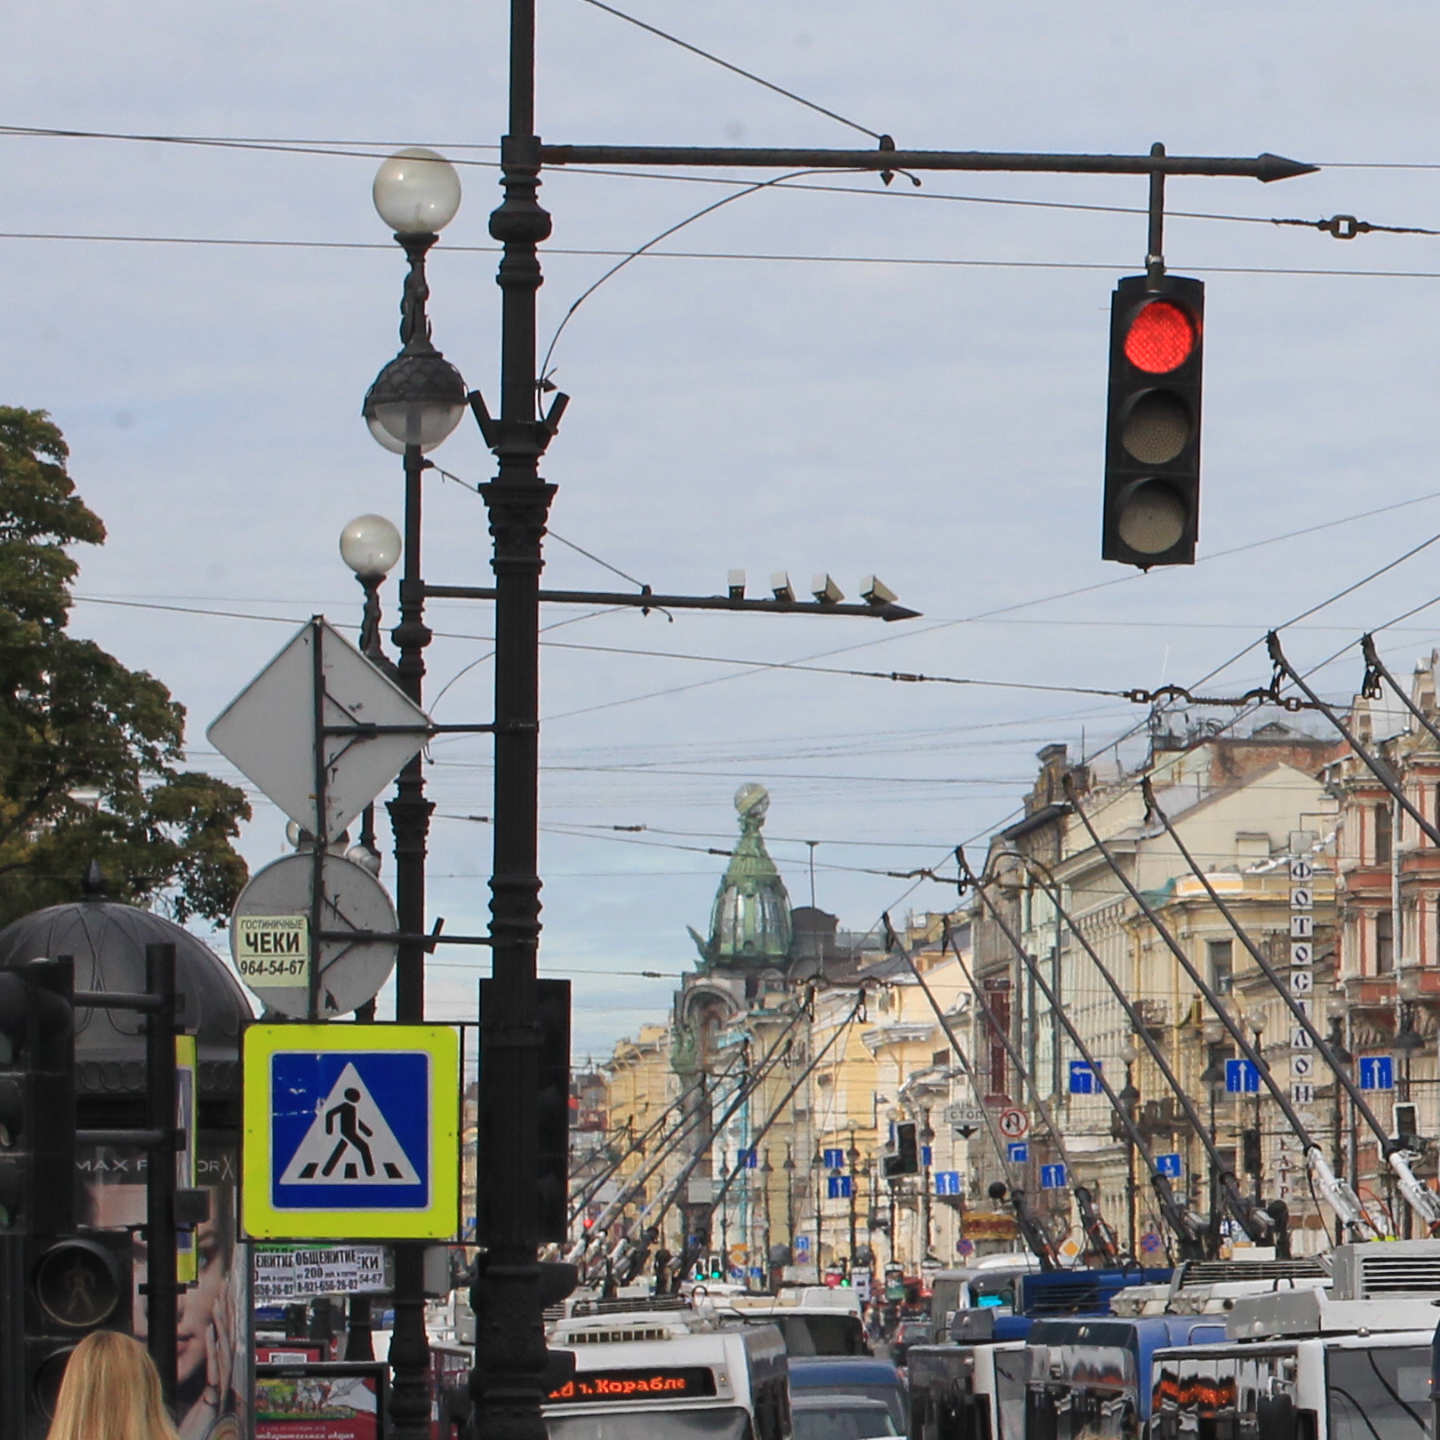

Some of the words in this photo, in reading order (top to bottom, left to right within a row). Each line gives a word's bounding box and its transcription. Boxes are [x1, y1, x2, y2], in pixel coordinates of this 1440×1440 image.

[241, 919, 304, 930] ГОСТИНИЧНЫЕ
[245, 932, 300, 953] ЧЕКИ
[240, 960, 305, 975] 964-54-67
[296, 1249, 356, 1267] ОБЩЕЖИТИЕ
[304, 1267, 324, 1279] 200
